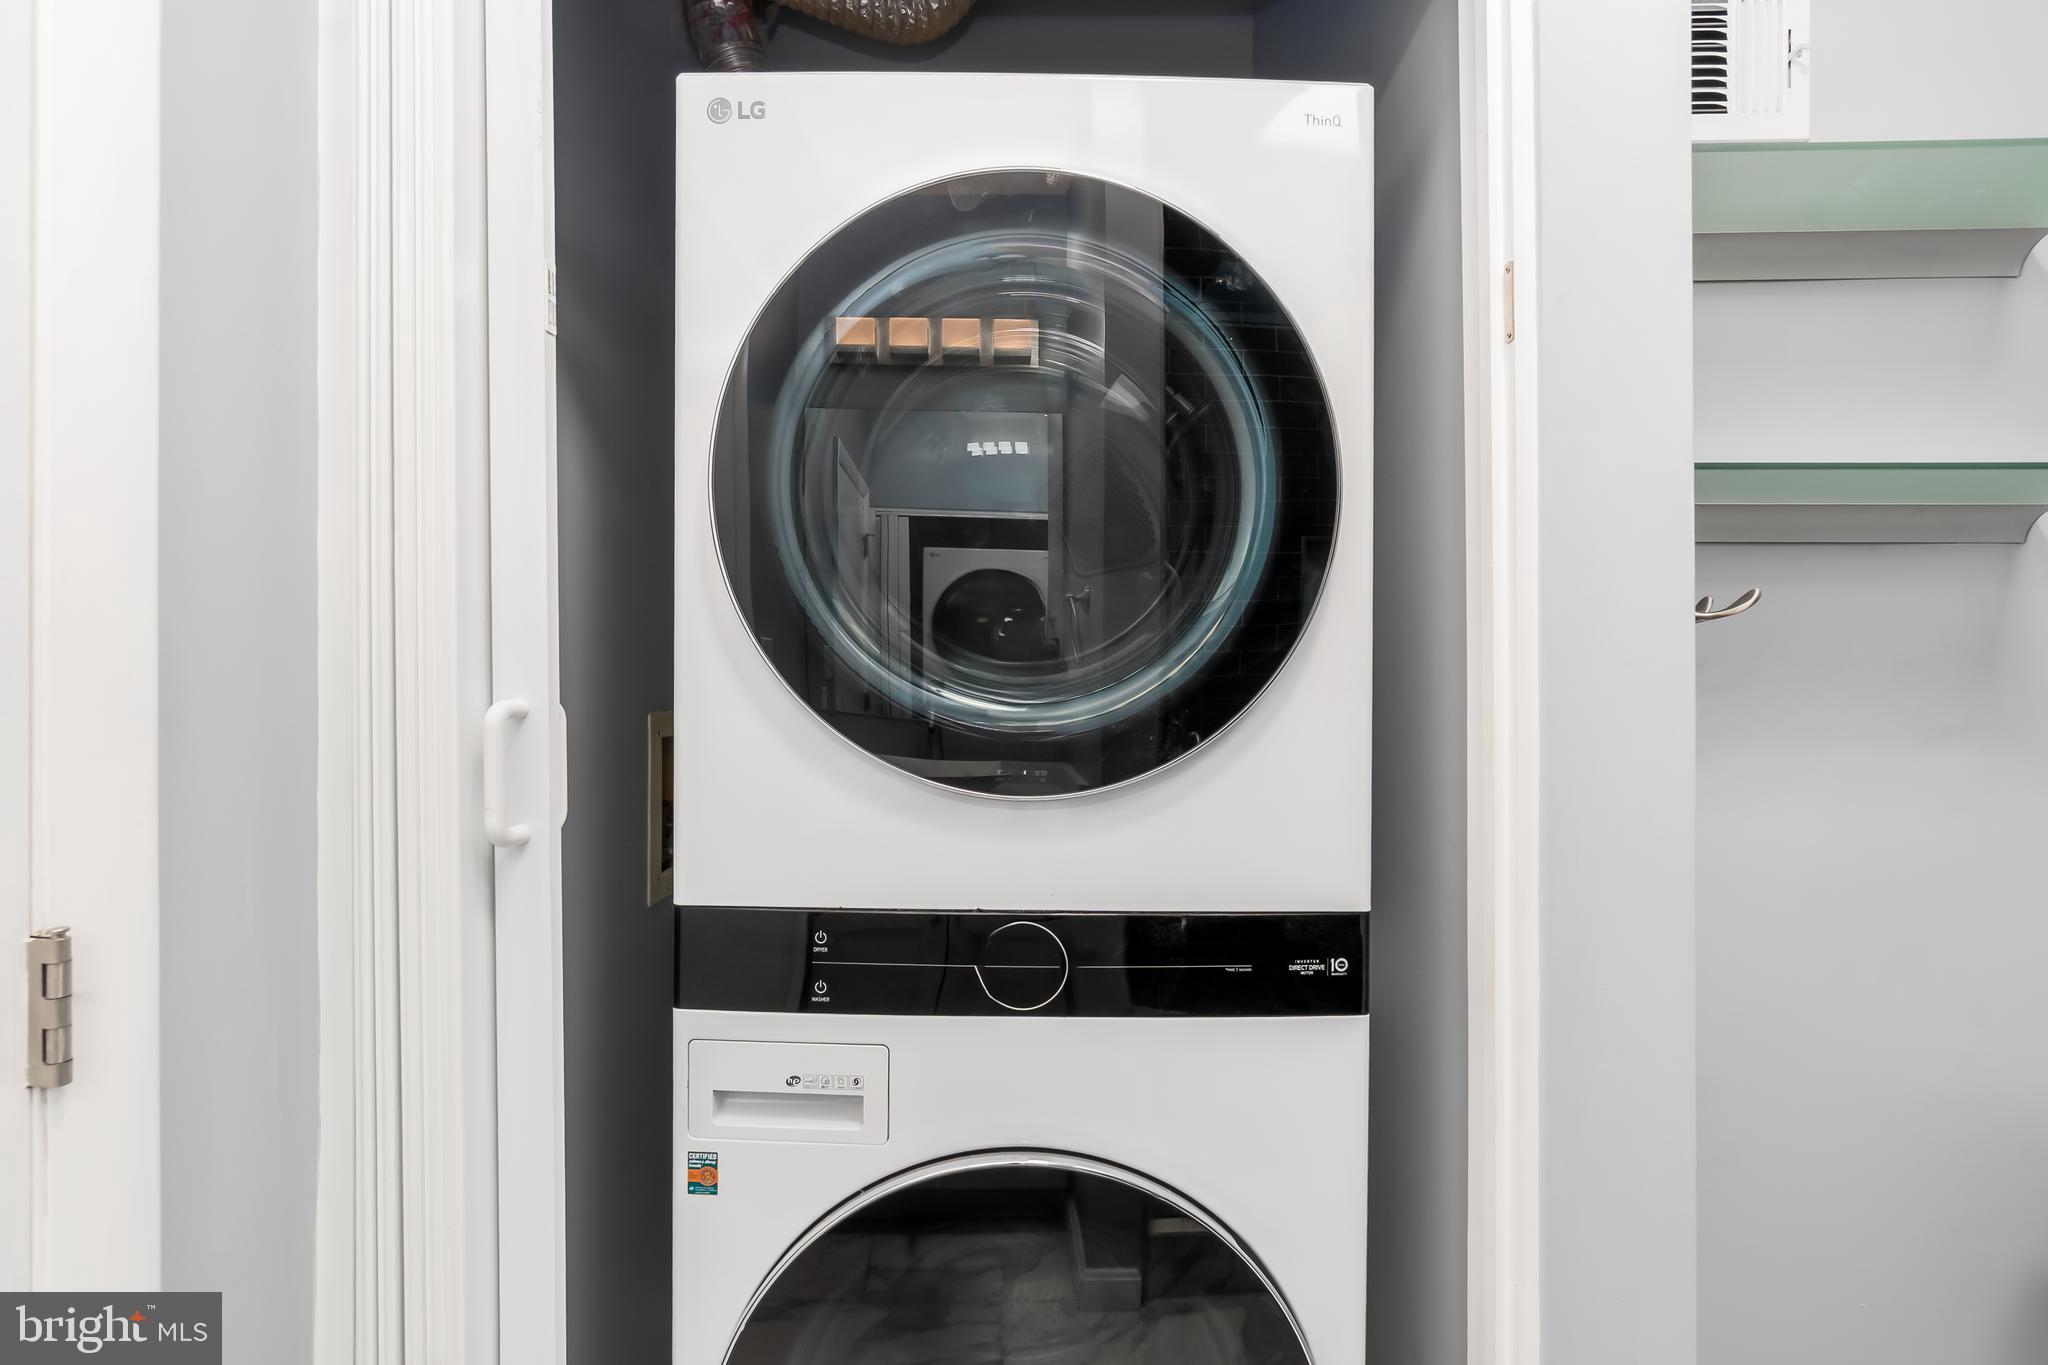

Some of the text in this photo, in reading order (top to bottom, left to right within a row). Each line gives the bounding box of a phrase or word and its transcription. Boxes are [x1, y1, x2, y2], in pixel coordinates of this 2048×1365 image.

[737, 100, 766, 120] LG
[1303, 113, 1344, 128] ThinQ
[688, 1152, 717, 1160] CERTIFIED
